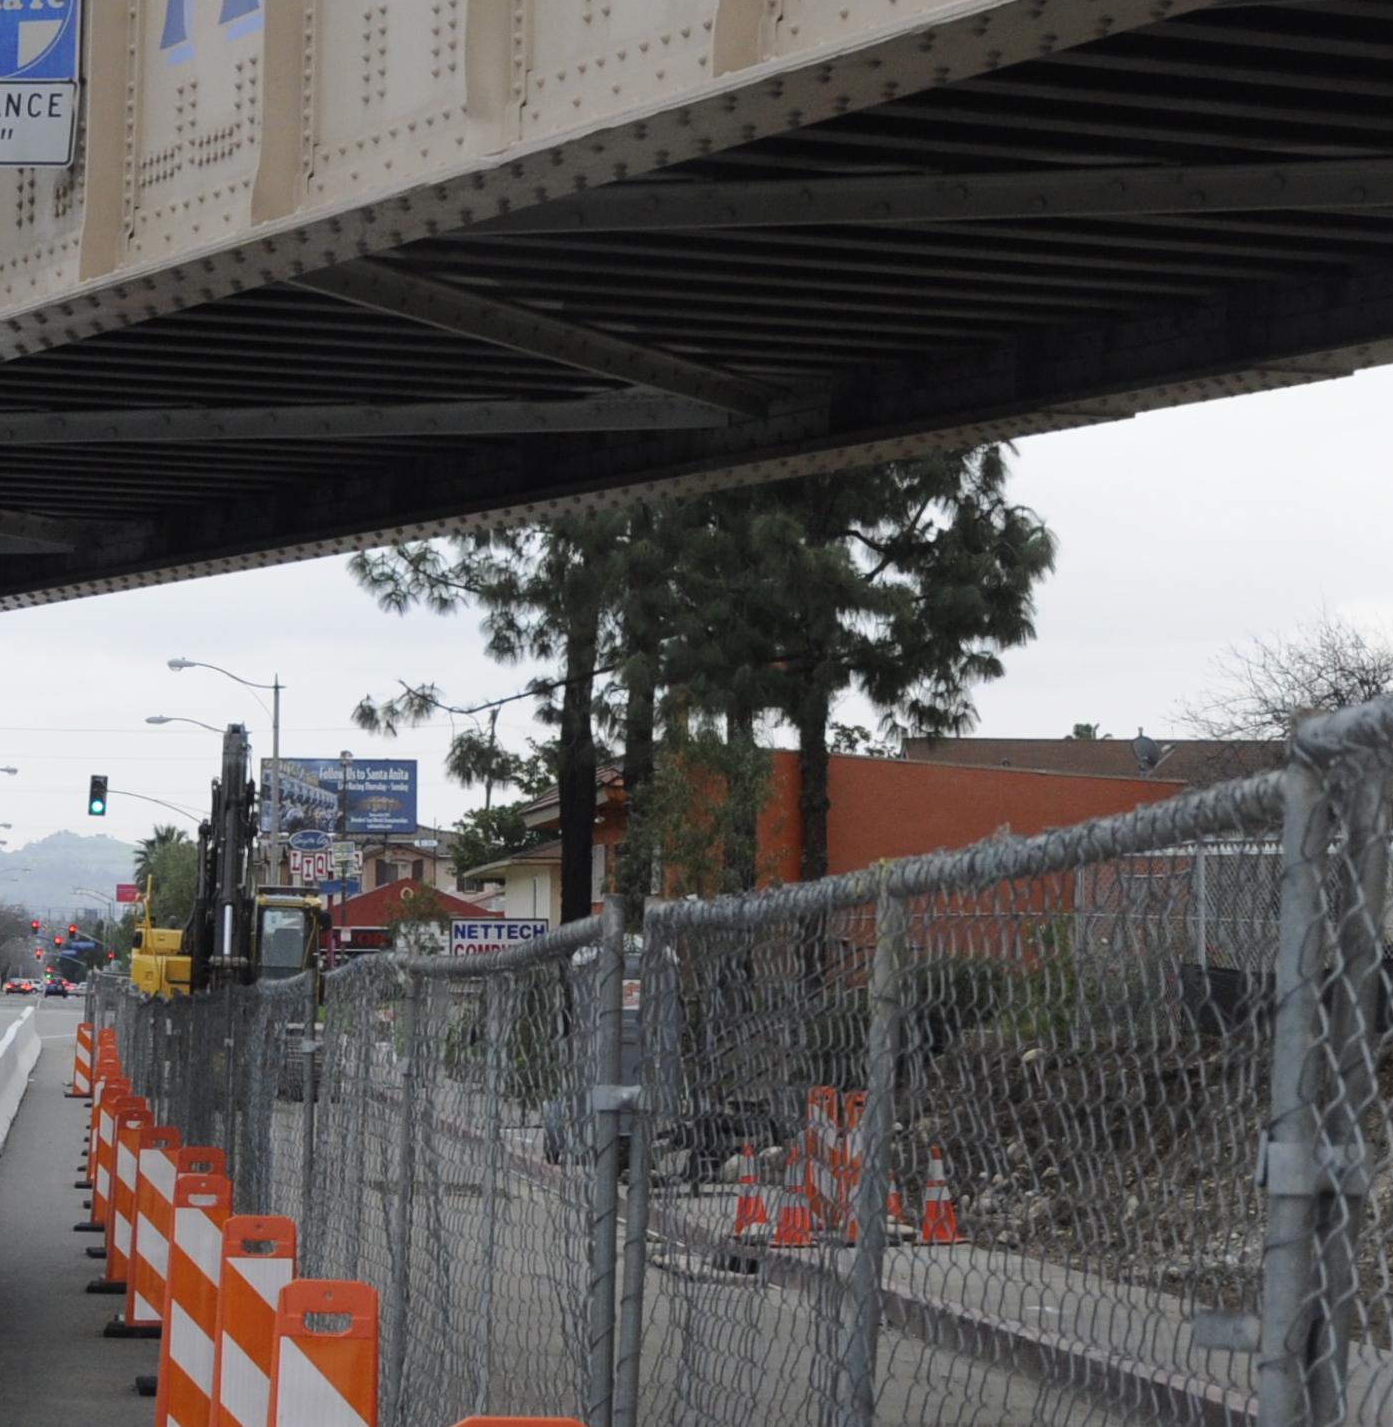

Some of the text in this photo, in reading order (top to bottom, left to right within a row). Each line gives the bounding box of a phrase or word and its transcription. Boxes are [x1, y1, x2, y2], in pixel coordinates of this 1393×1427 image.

[357, 768, 366, 780] to
[366, 767, 388, 780] Santa
[389, 767, 409, 780] Anita
[291, 850, 363, 878] LIQUR
[454, 924, 545, 940] NETTECH
